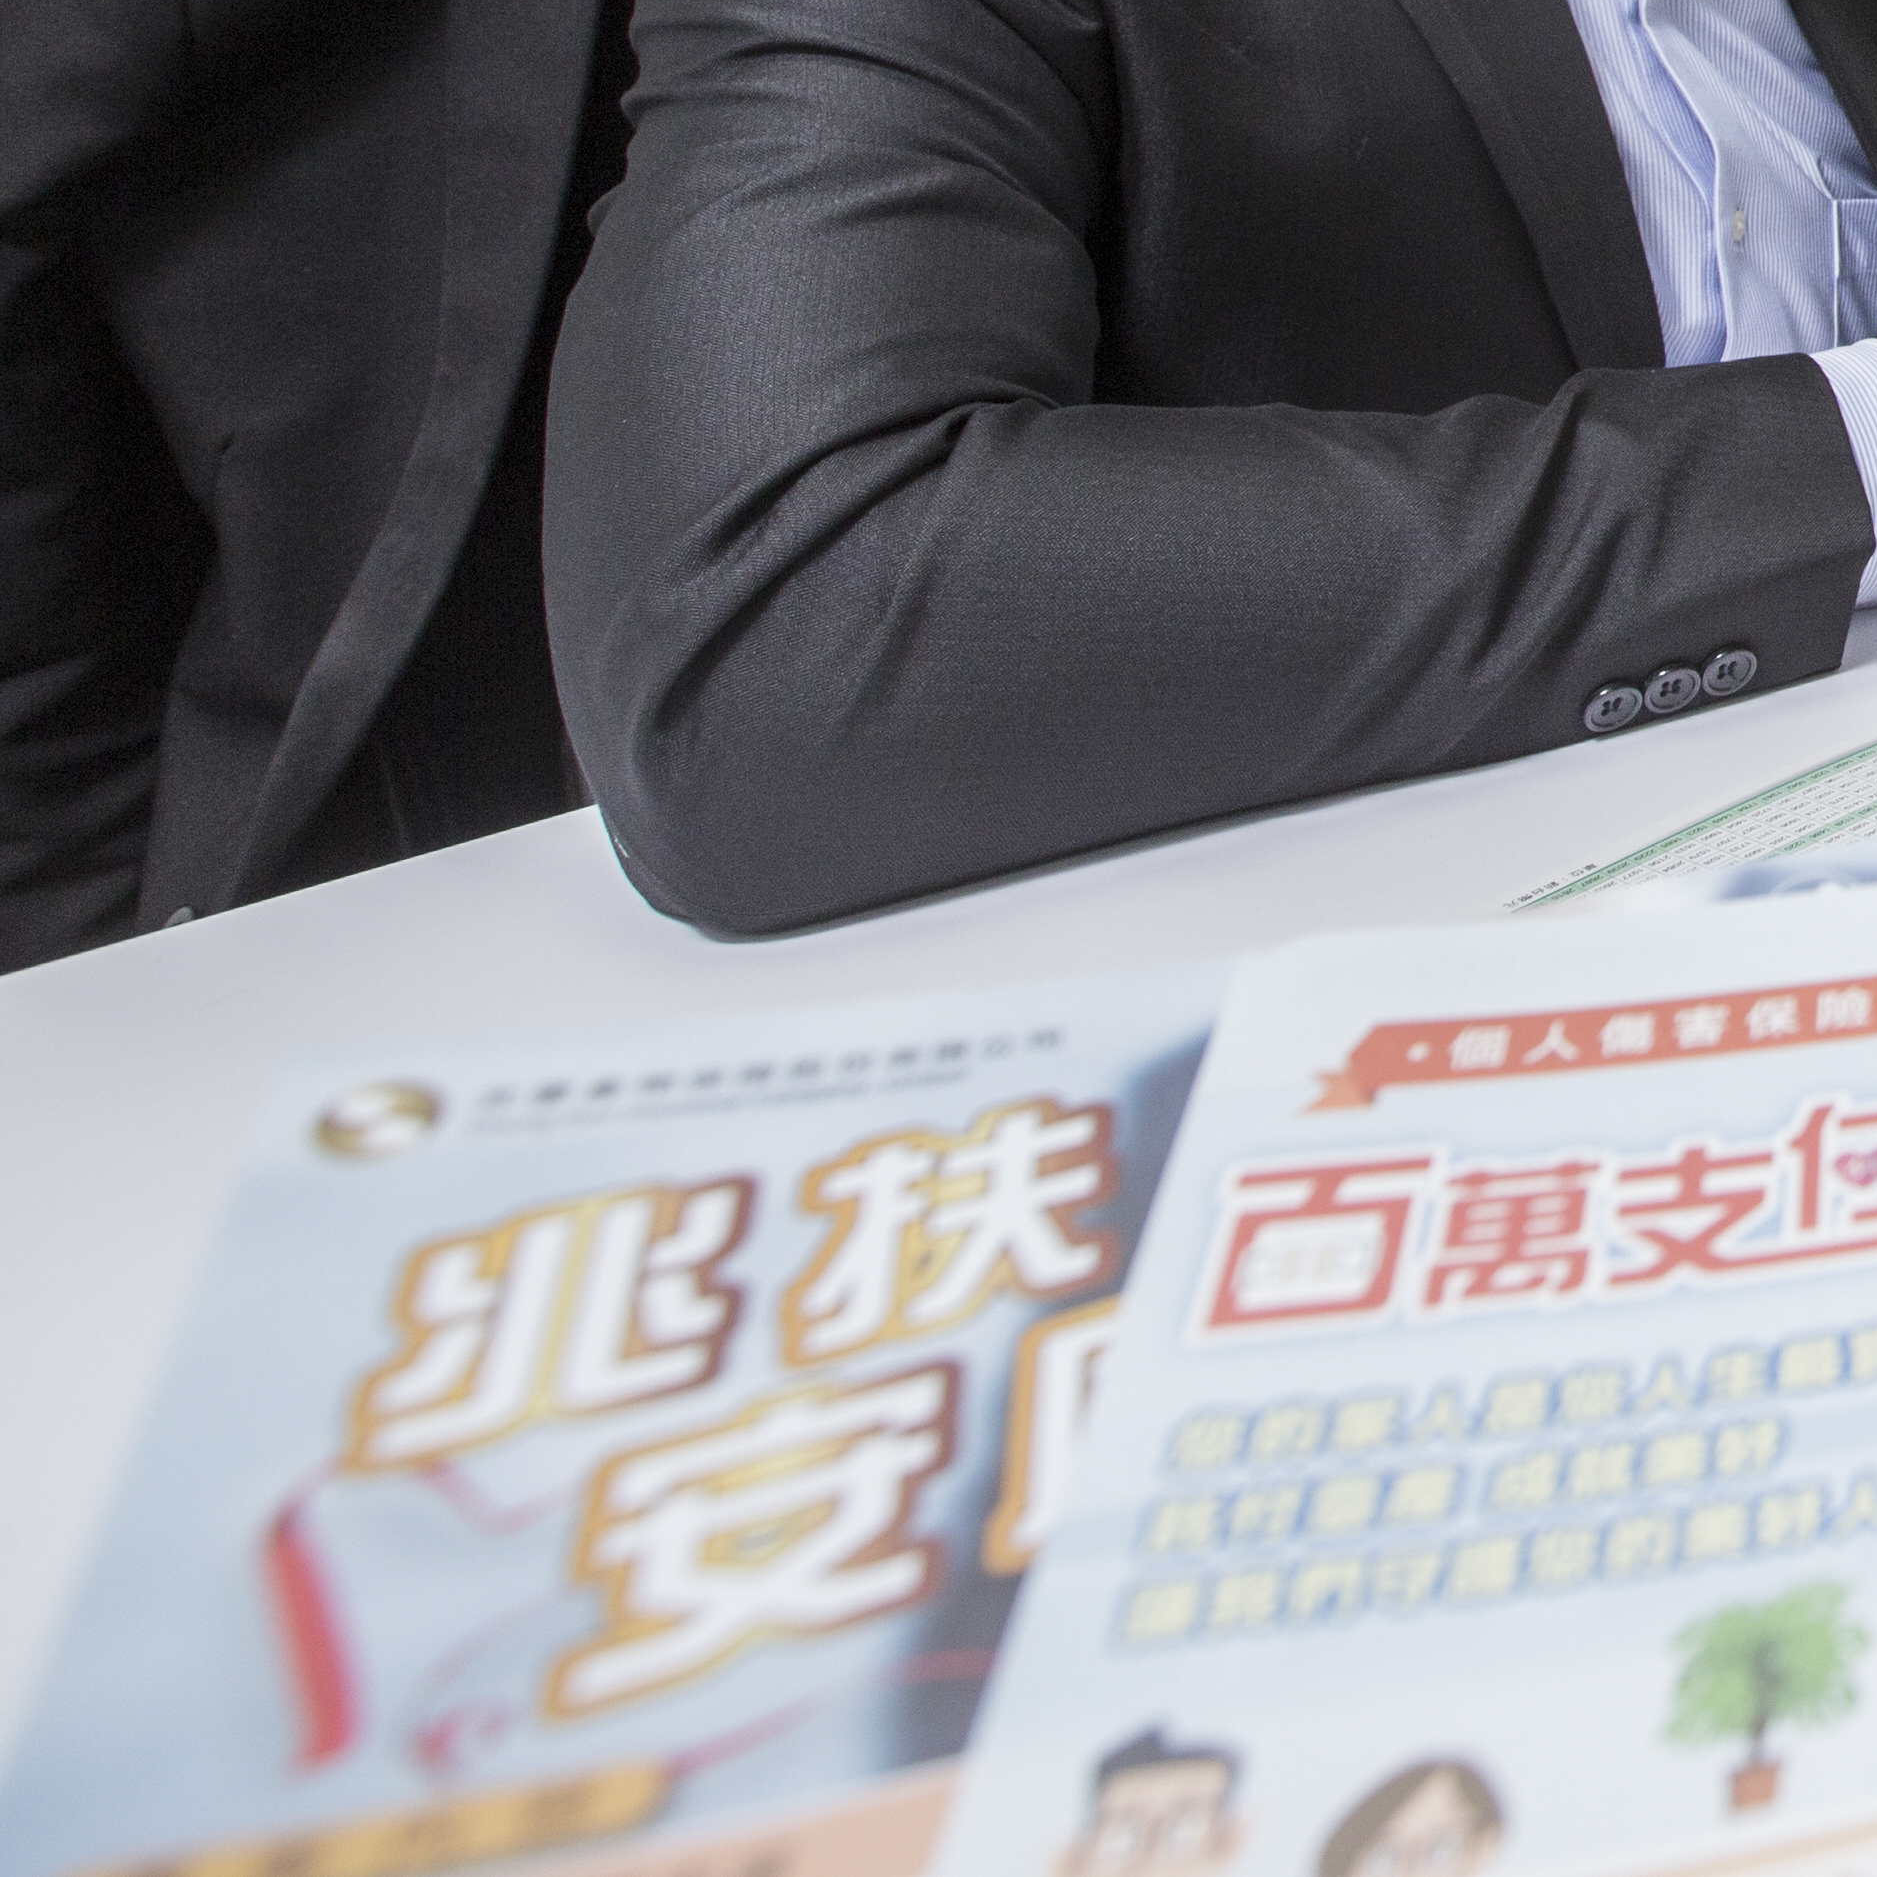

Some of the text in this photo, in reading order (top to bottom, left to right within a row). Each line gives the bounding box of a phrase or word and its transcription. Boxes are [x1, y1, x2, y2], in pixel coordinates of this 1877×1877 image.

[1502, 863, 1598, 908] 單位：新台幣元
